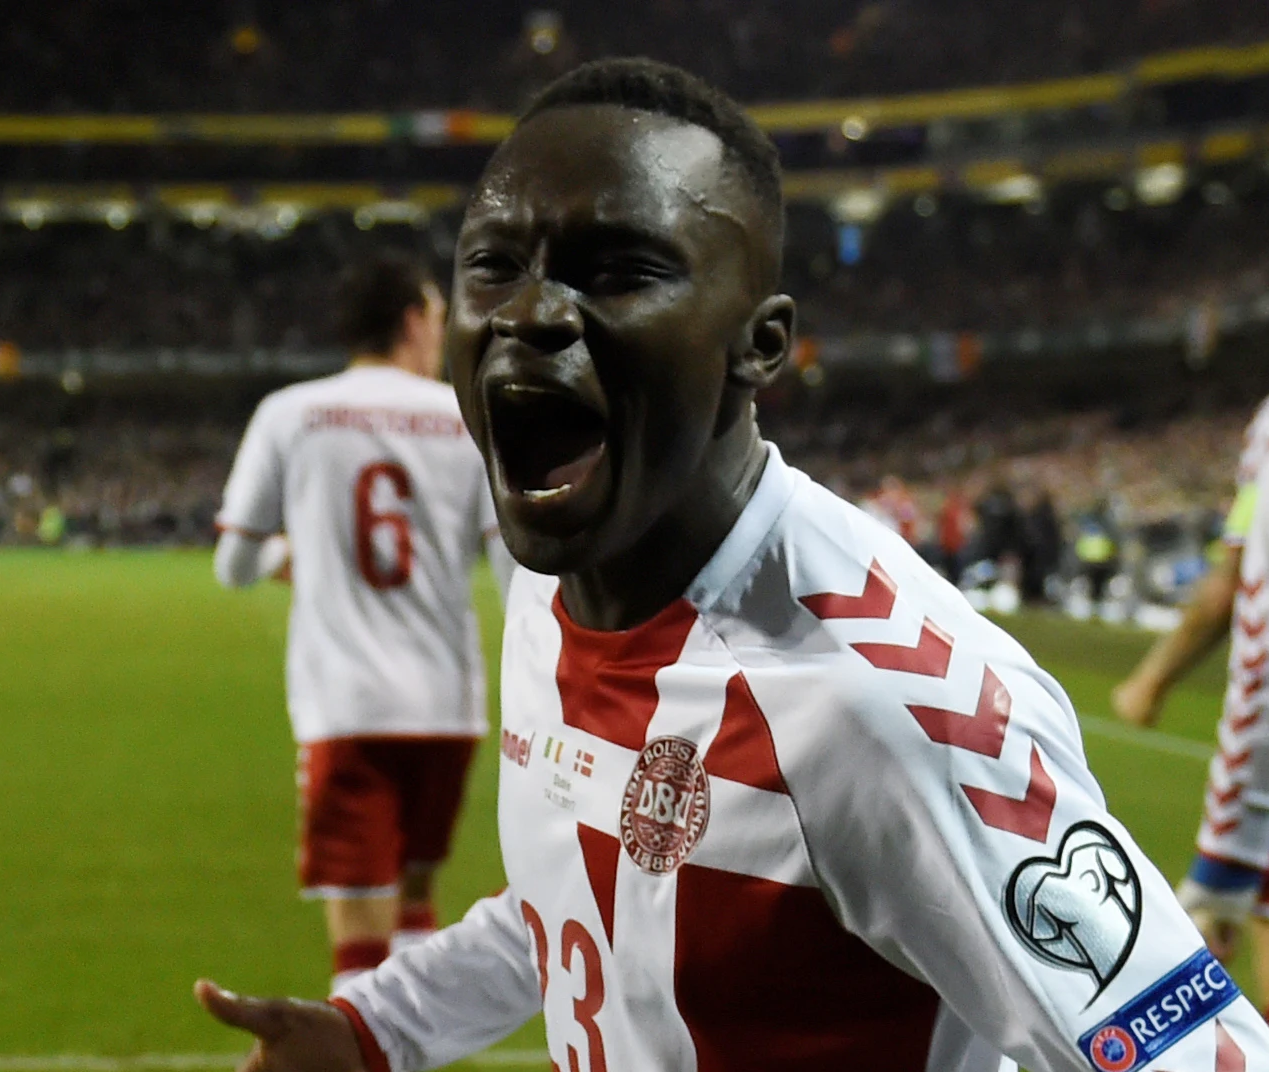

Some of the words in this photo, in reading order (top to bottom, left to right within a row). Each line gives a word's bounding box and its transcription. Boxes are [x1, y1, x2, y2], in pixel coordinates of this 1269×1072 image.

[355, 460, 415, 591] 6
[635, 778, 695, 829] DBU
[1130, 958, 1229, 1044] RESPEC
